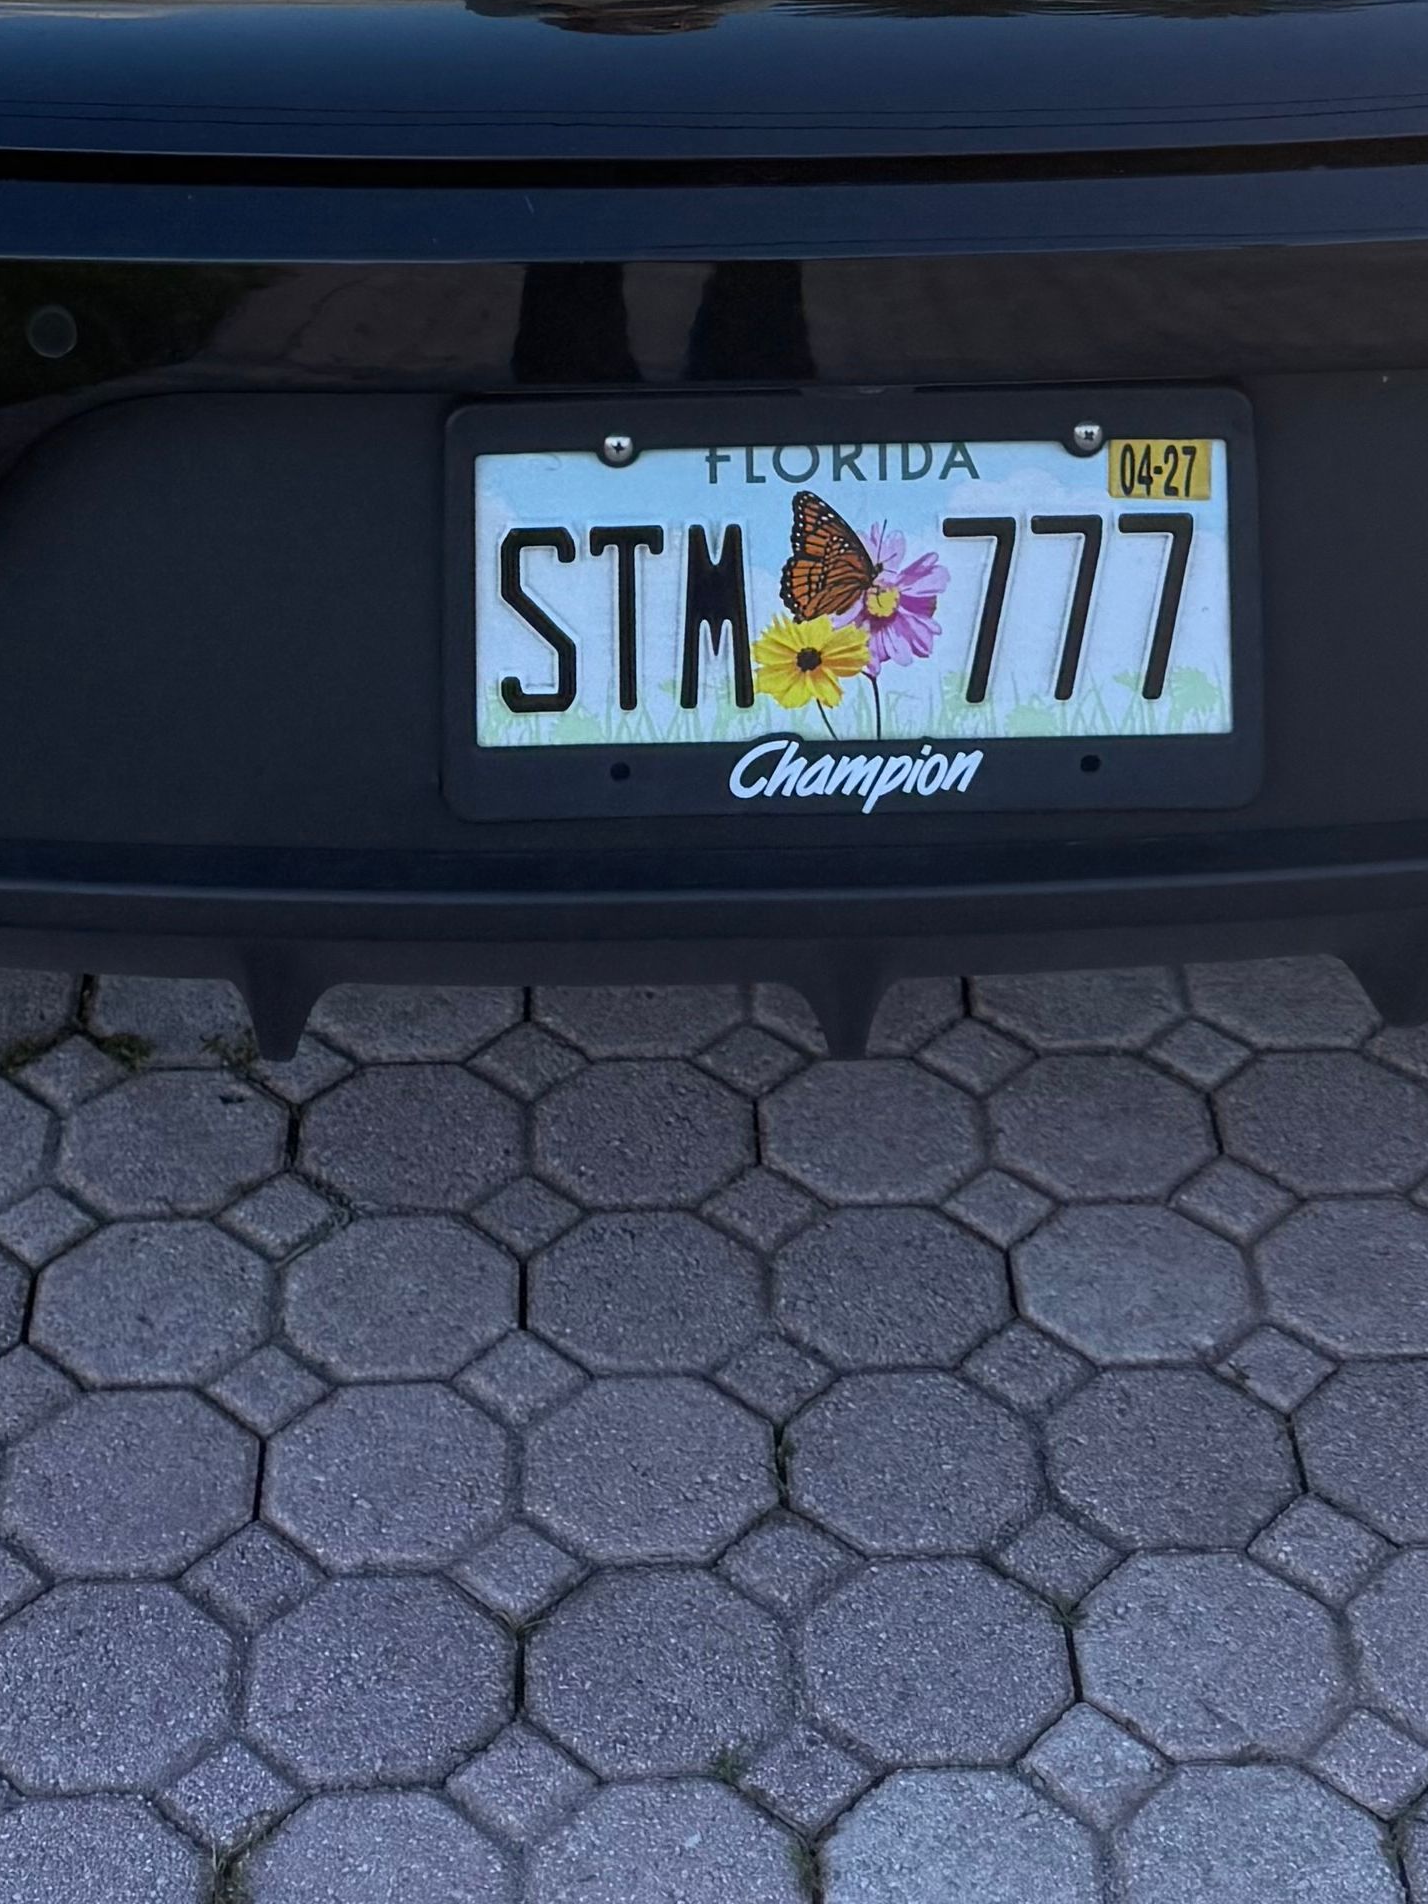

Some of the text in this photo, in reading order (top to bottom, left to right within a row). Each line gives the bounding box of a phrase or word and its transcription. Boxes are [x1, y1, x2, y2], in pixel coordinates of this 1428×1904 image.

[705, 442, 980, 484] FLORIDA
[1120, 443, 1197, 497] 04-27
[500, 512, 1194, 714] STM 777
[729, 739, 983, 814] Champion
